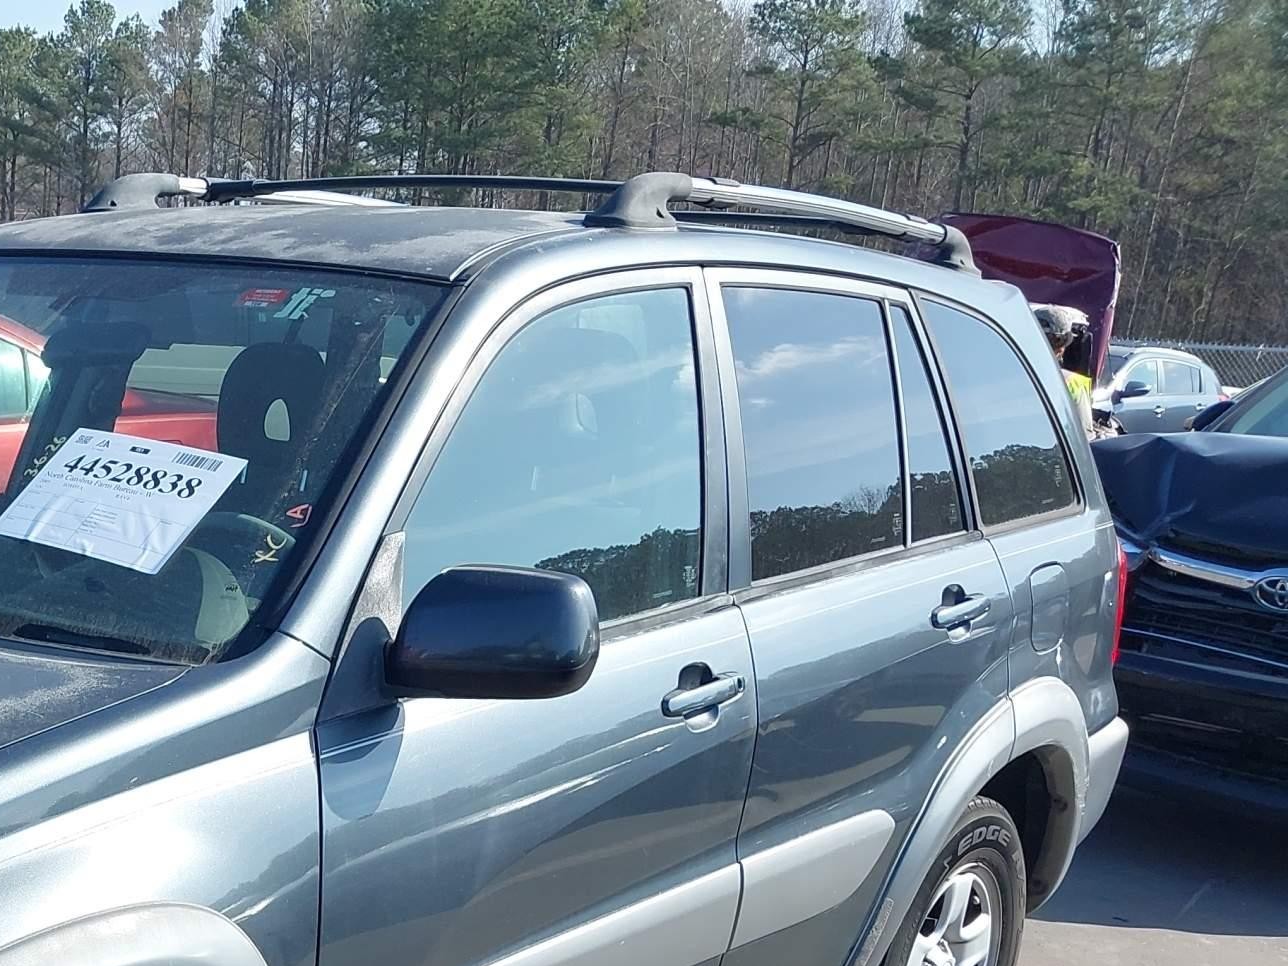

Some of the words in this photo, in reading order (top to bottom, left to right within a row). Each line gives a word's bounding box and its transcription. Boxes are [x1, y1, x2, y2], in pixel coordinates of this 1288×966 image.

[64, 454, 203, 499] 44528838
[64, 473, 93, 487] Carolina
[94, 480, 112, 489] Farm
[113, 483, 138, 496] Bureau
[957, 825, 1012, 856] EDGE
